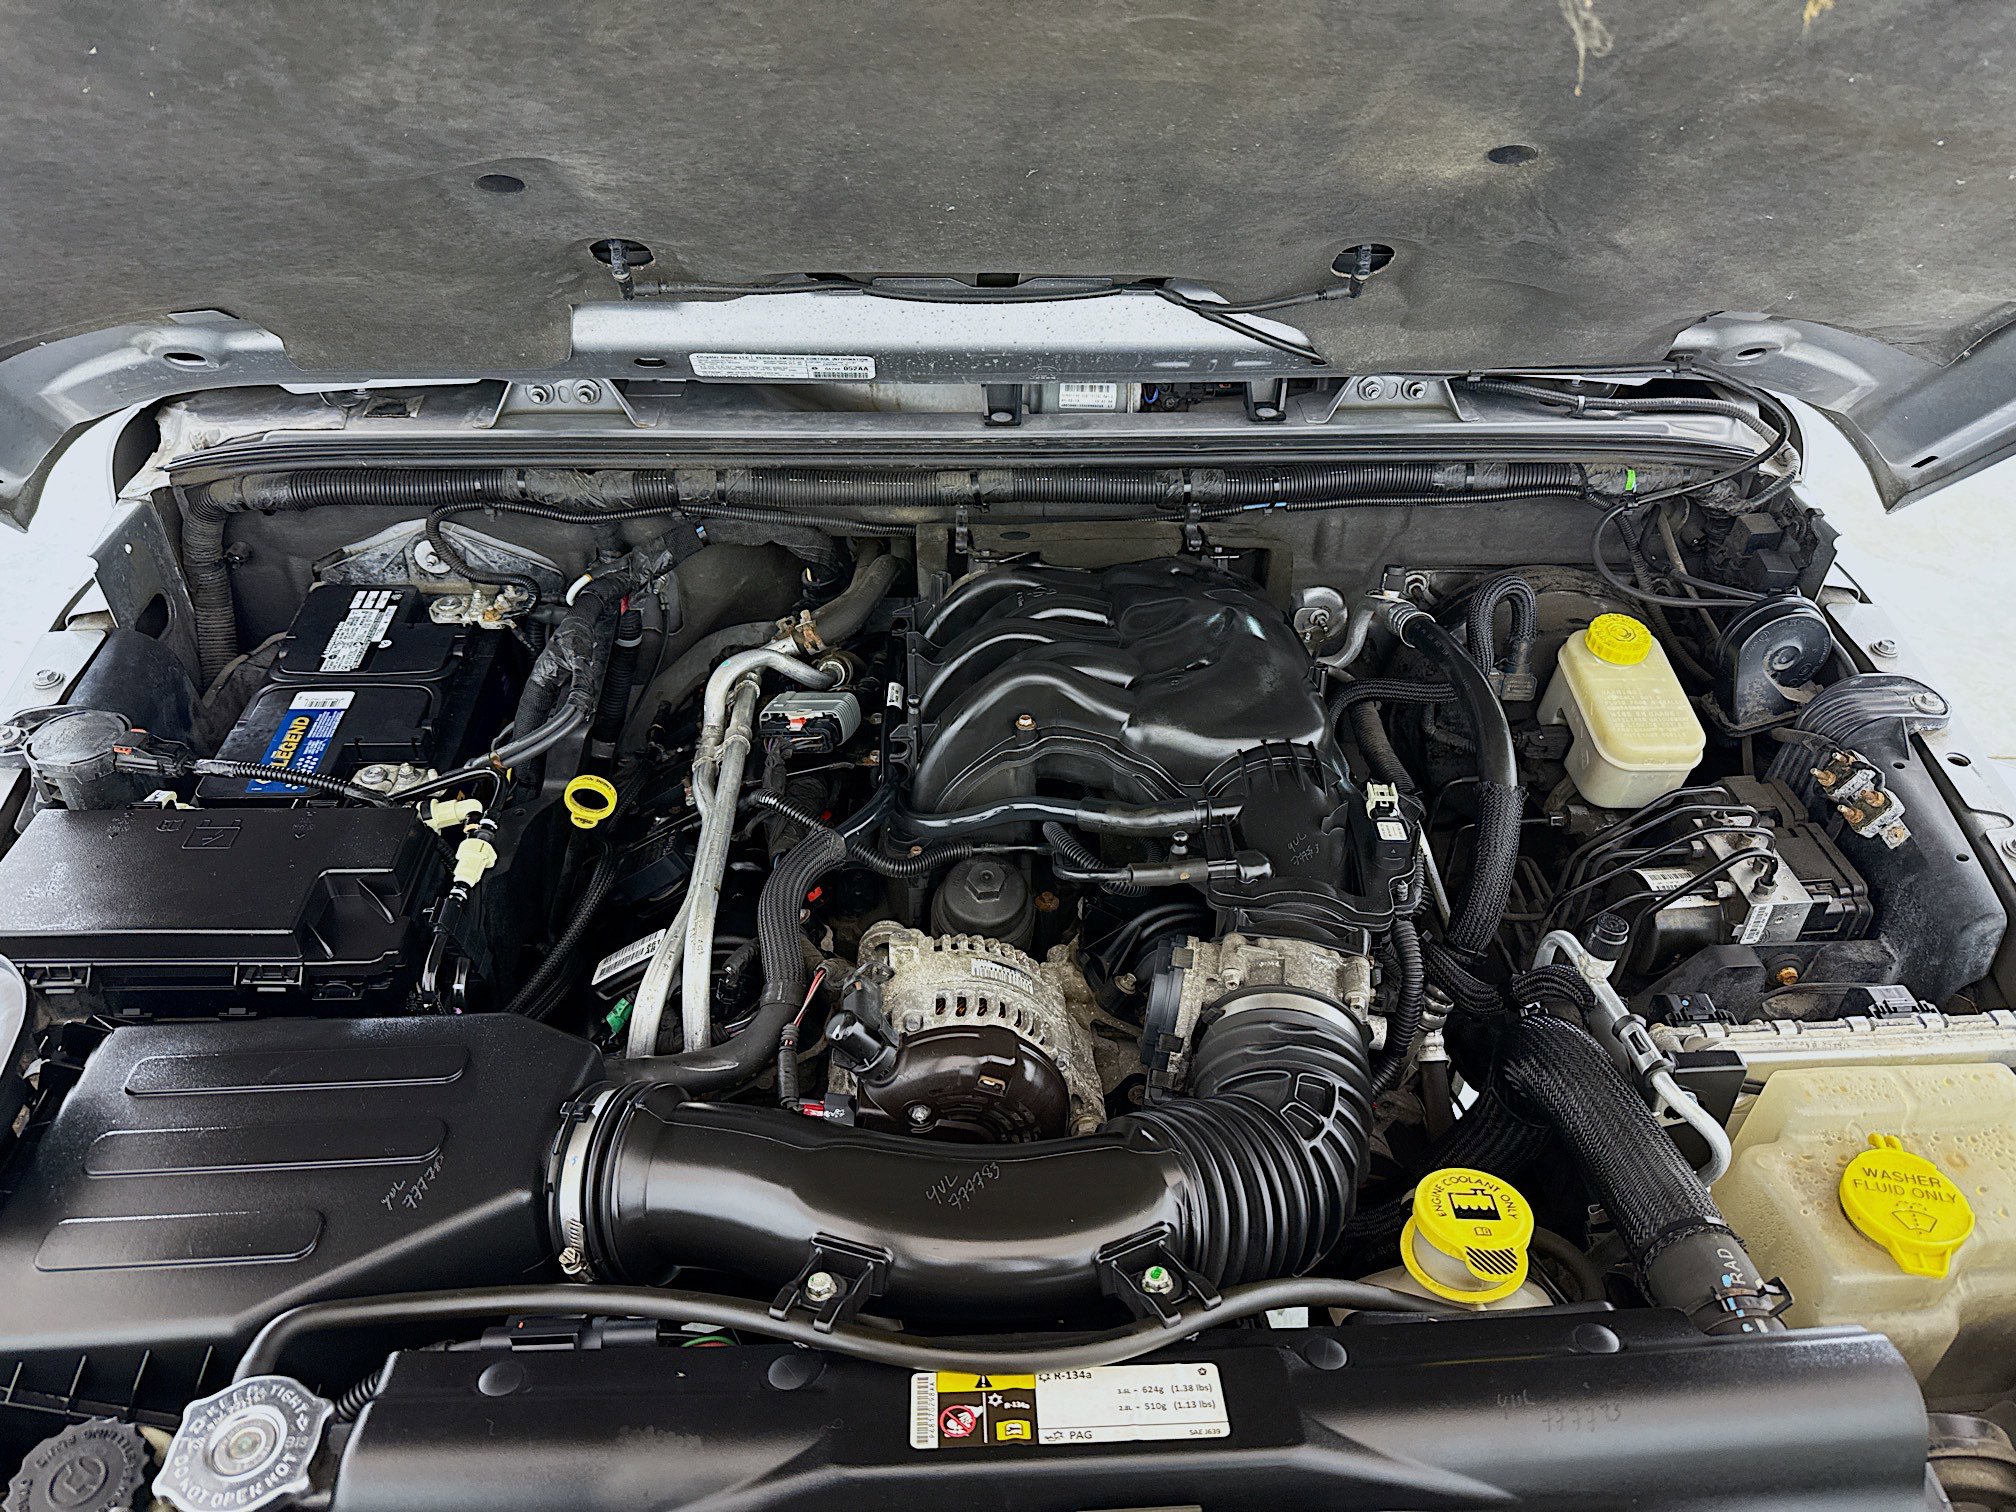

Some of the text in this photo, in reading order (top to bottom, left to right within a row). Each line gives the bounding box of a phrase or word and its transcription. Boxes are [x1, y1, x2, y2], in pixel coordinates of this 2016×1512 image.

[271, 716, 310, 768] LEGEND
[1862, 1166, 1942, 1189] WASHER
[1431, 1175, 1519, 1220] ENGINE COOLANT ONLY
[1853, 1178, 1957, 1204] FLUID ONLY
[1716, 1248, 1747, 1285] RAD
[1054, 1370, 1093, 1380] R-134a
[1142, 1385, 1165, 1395] 624g
[1171, 1384, 1194, 1394] (1.38
[1196, 1383, 1213, 1393] lbs)
[1144, 1402, 1167, 1411] 510g
[1173, 1400, 1197, 1410] (1.13
[1199, 1399, 1216, 1409] lbs)
[1069, 1430, 1093, 1440] PAG
[210, 1481, 263, 1509] OPEN
[264, 1452, 298, 1488] HOT
